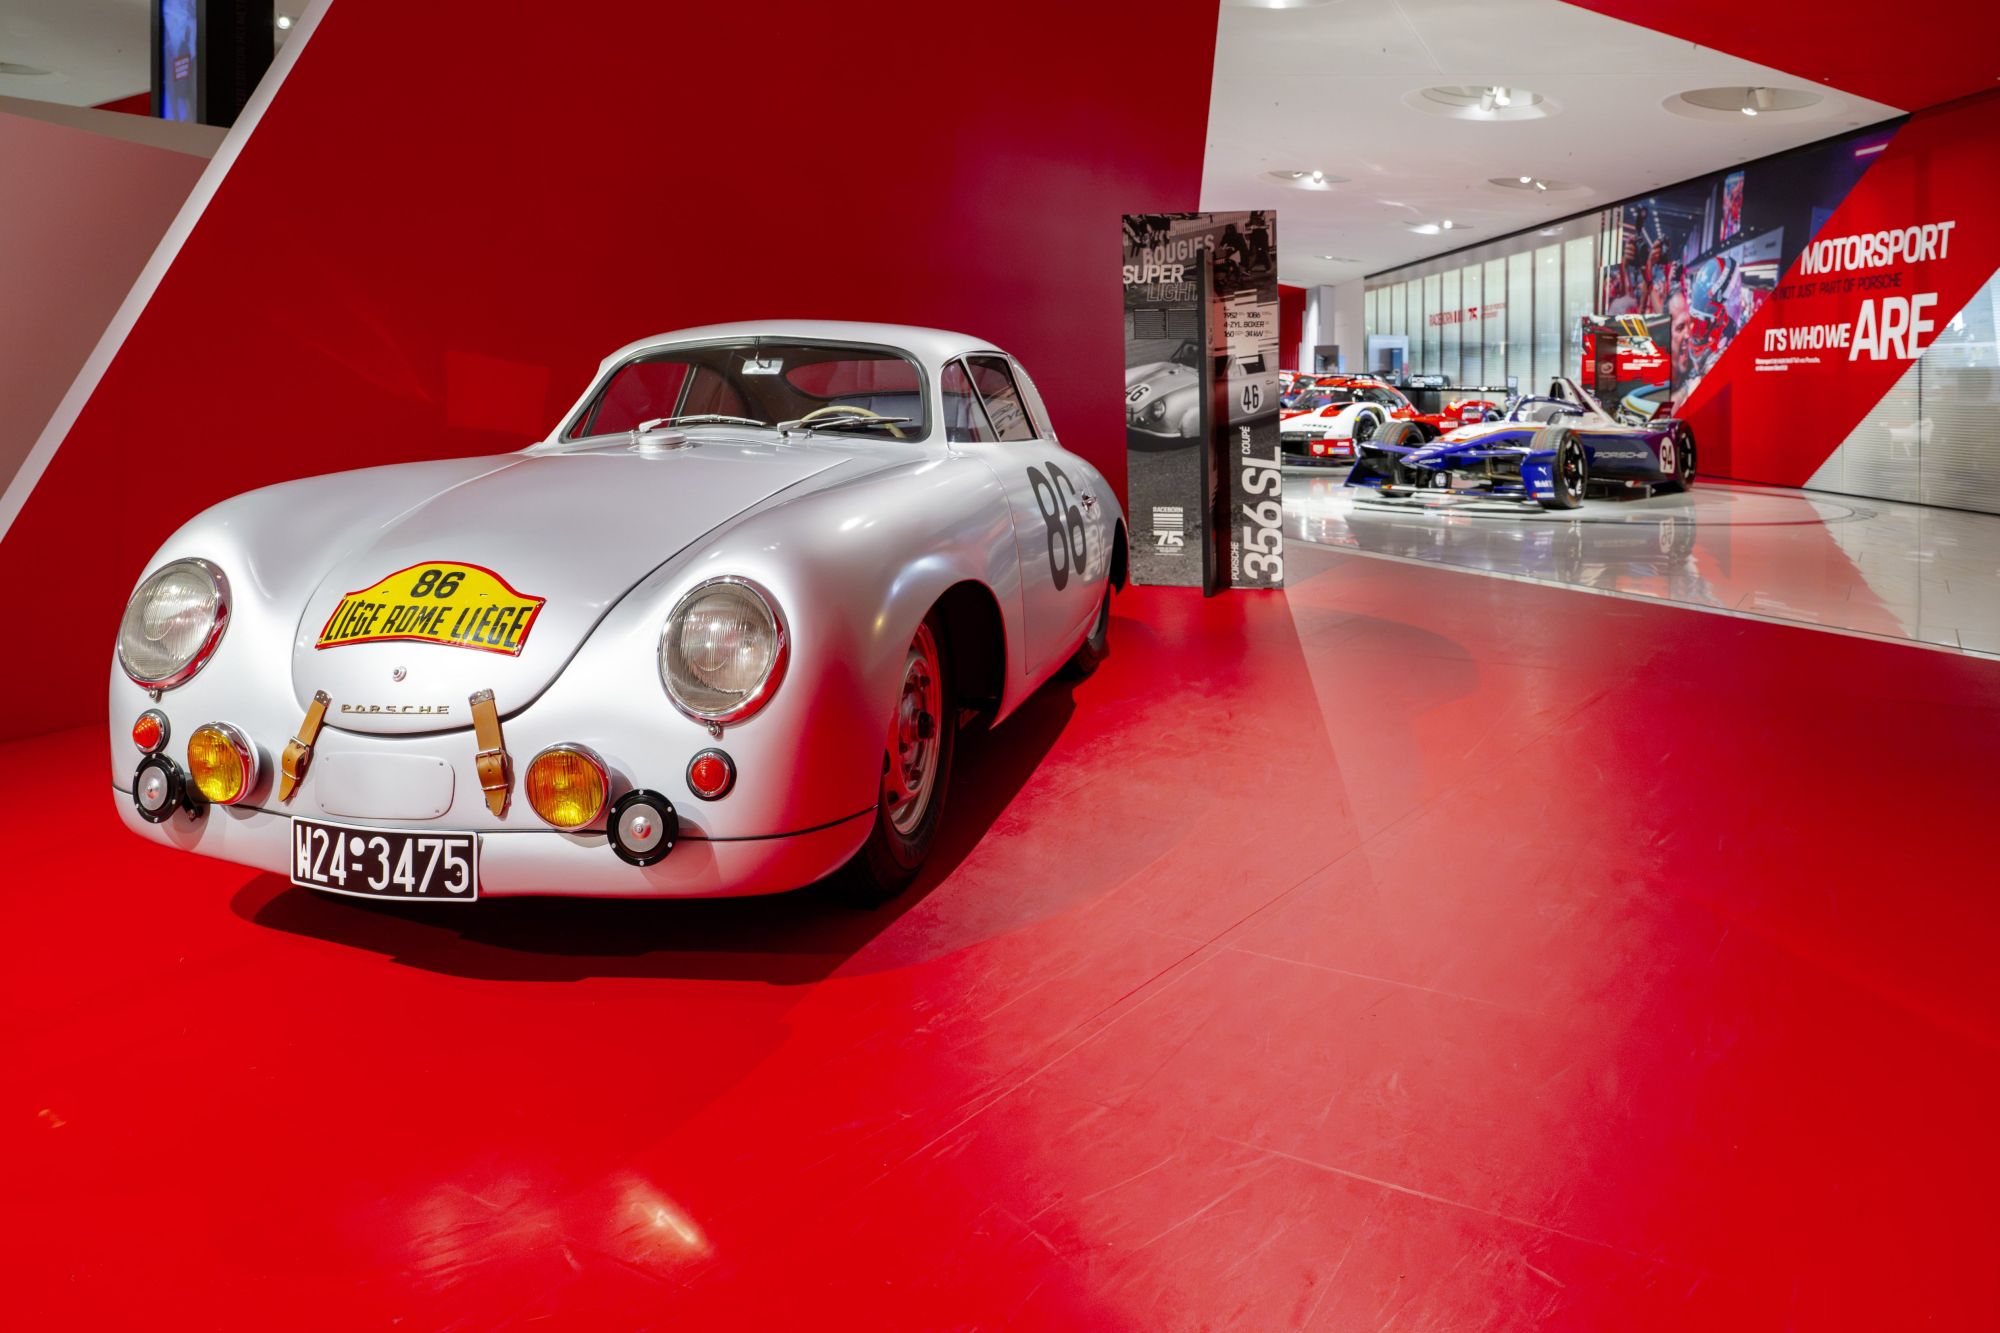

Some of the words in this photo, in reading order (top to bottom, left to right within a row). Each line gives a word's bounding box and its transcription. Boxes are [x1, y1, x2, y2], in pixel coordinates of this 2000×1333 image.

[1800, 220, 1956, 276] MOTORSPORT
[1122, 264, 1185, 285] SUPER
[1779, 284, 1796, 300] NOT
[1797, 281, 1817, 299] JUST
[1818, 278, 1842, 295] PART
[1842, 277, 1856, 292] OF
[1857, 271, 1903, 290] PORSCHE
[1243, 320, 1265, 328] BOXER
[1764, 328, 1787, 352] IT'S
[1789, 324, 1825, 351] WHO
[1825, 322, 1852, 349] WE
[1848, 291, 1938, 361] ARE
[1243, 384, 1259, 411] 46
[1239, 425, 1251, 455] COUPÉ
[1593, 451, 1649, 459] PORSCHE
[1241, 446, 1282, 497] SL
[1661, 444, 1674, 470] 94
[1026, 460, 1088, 592] 86
[1153, 530, 1185, 547] 75
[1243, 501, 1284, 582] 356
[1230, 541, 1240, 581] PORSCHE
[410, 569, 466, 599] 86
[325, 599, 388, 641] LIÈGE
[379, 605, 453, 636] ROME
[450, 603, 533, 648] LIÈGE
[341, 704, 451, 714] PORSCHE
